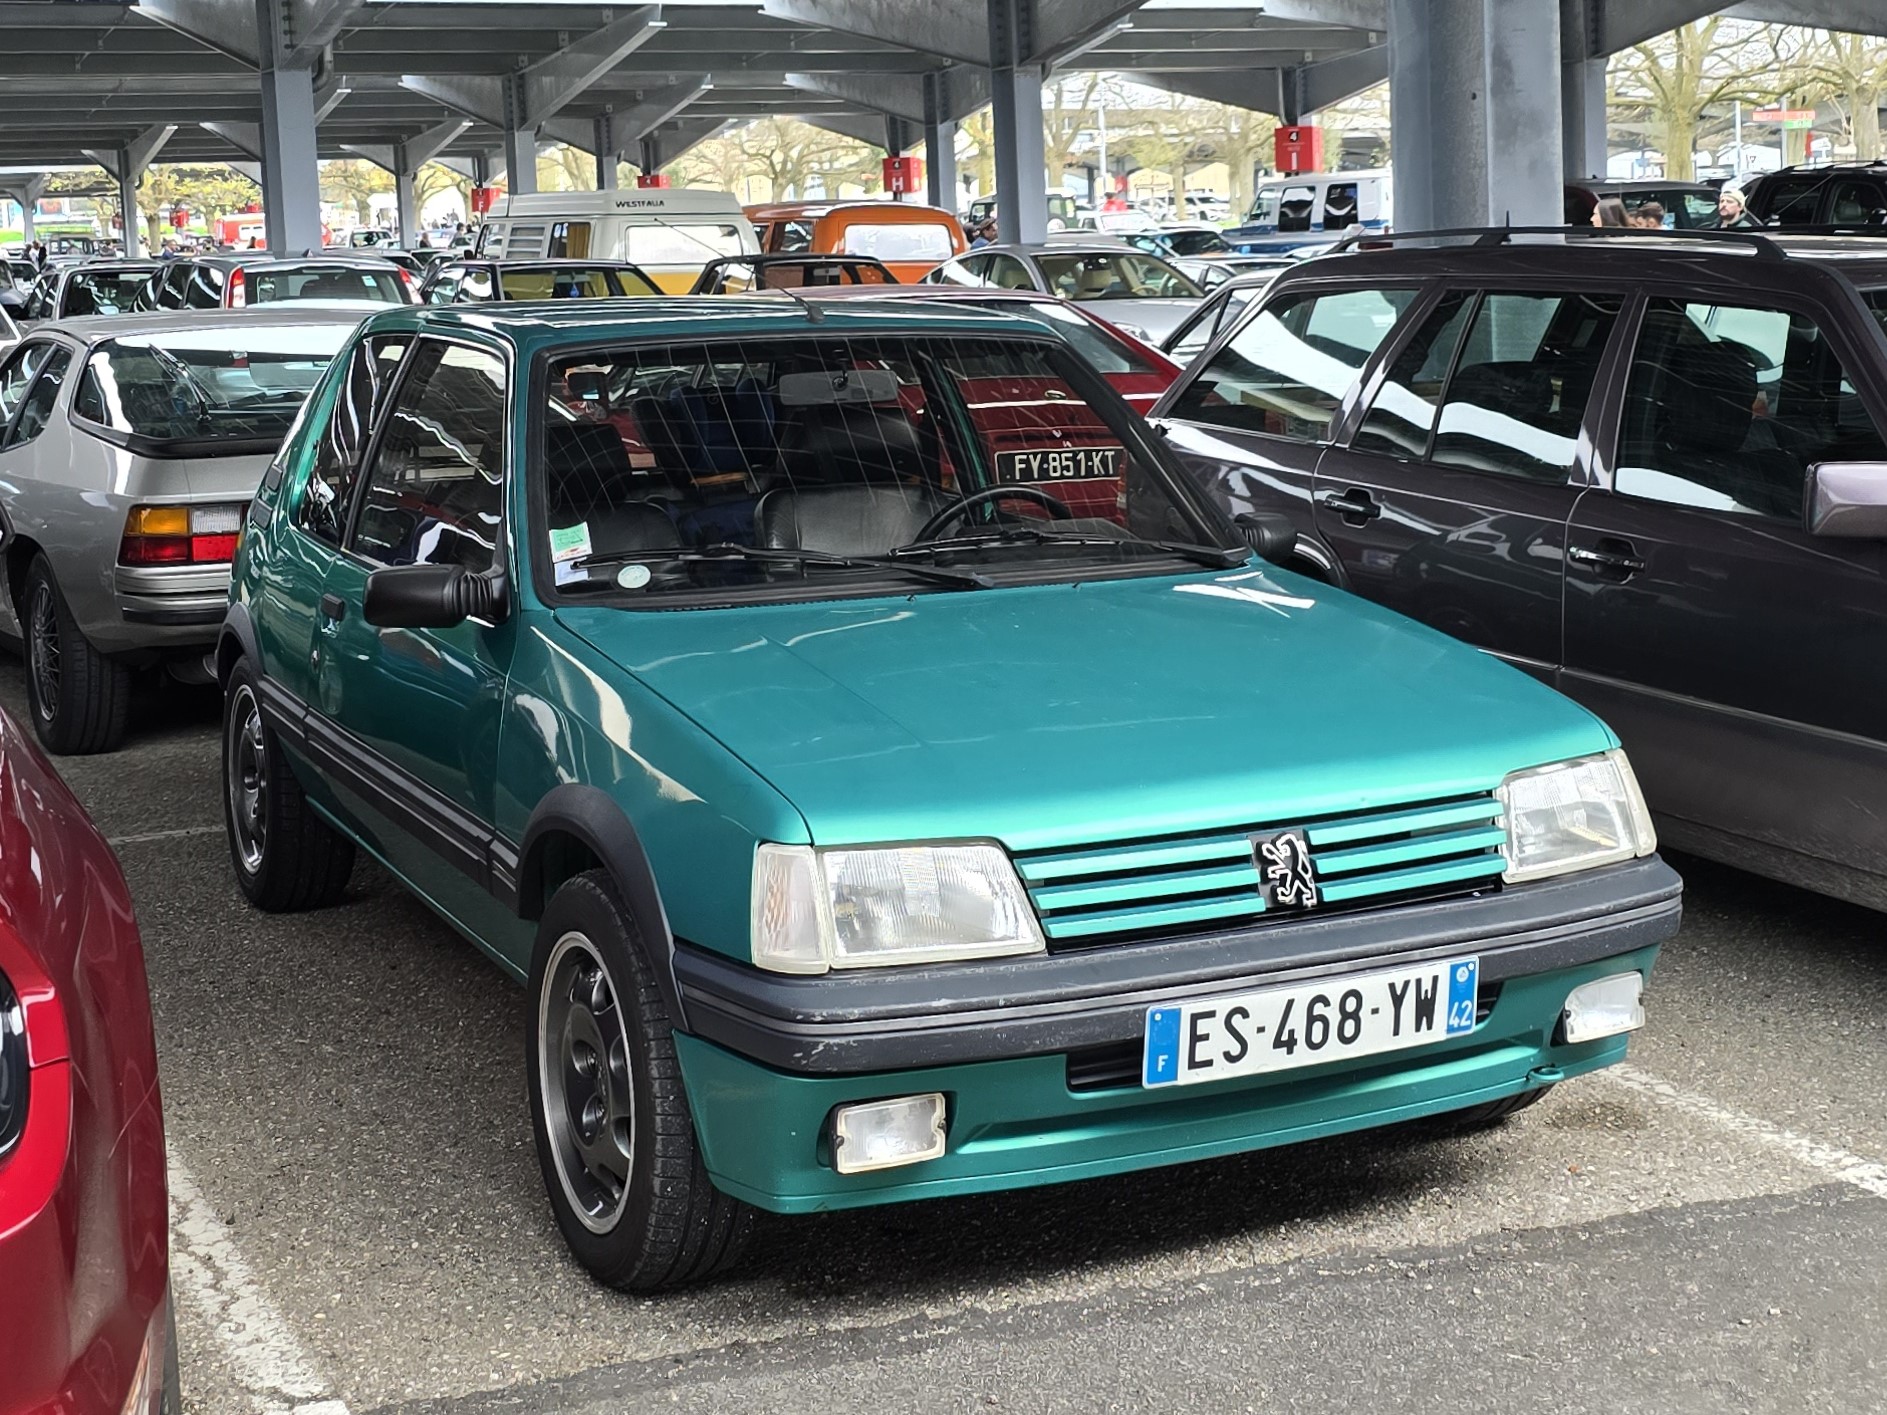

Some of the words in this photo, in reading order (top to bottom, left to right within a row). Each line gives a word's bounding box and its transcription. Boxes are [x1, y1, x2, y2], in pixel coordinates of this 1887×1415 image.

[1290, 132, 1297, 141] 4
[892, 176, 904, 191] H
[478, 200, 484, 211] F
[615, 200, 665, 208] WESTFALIA
[1449, 1000, 1473, 1027] 42
[1187, 975, 1439, 1070] ES-468-YW
[1157, 1055, 1168, 1072] F
